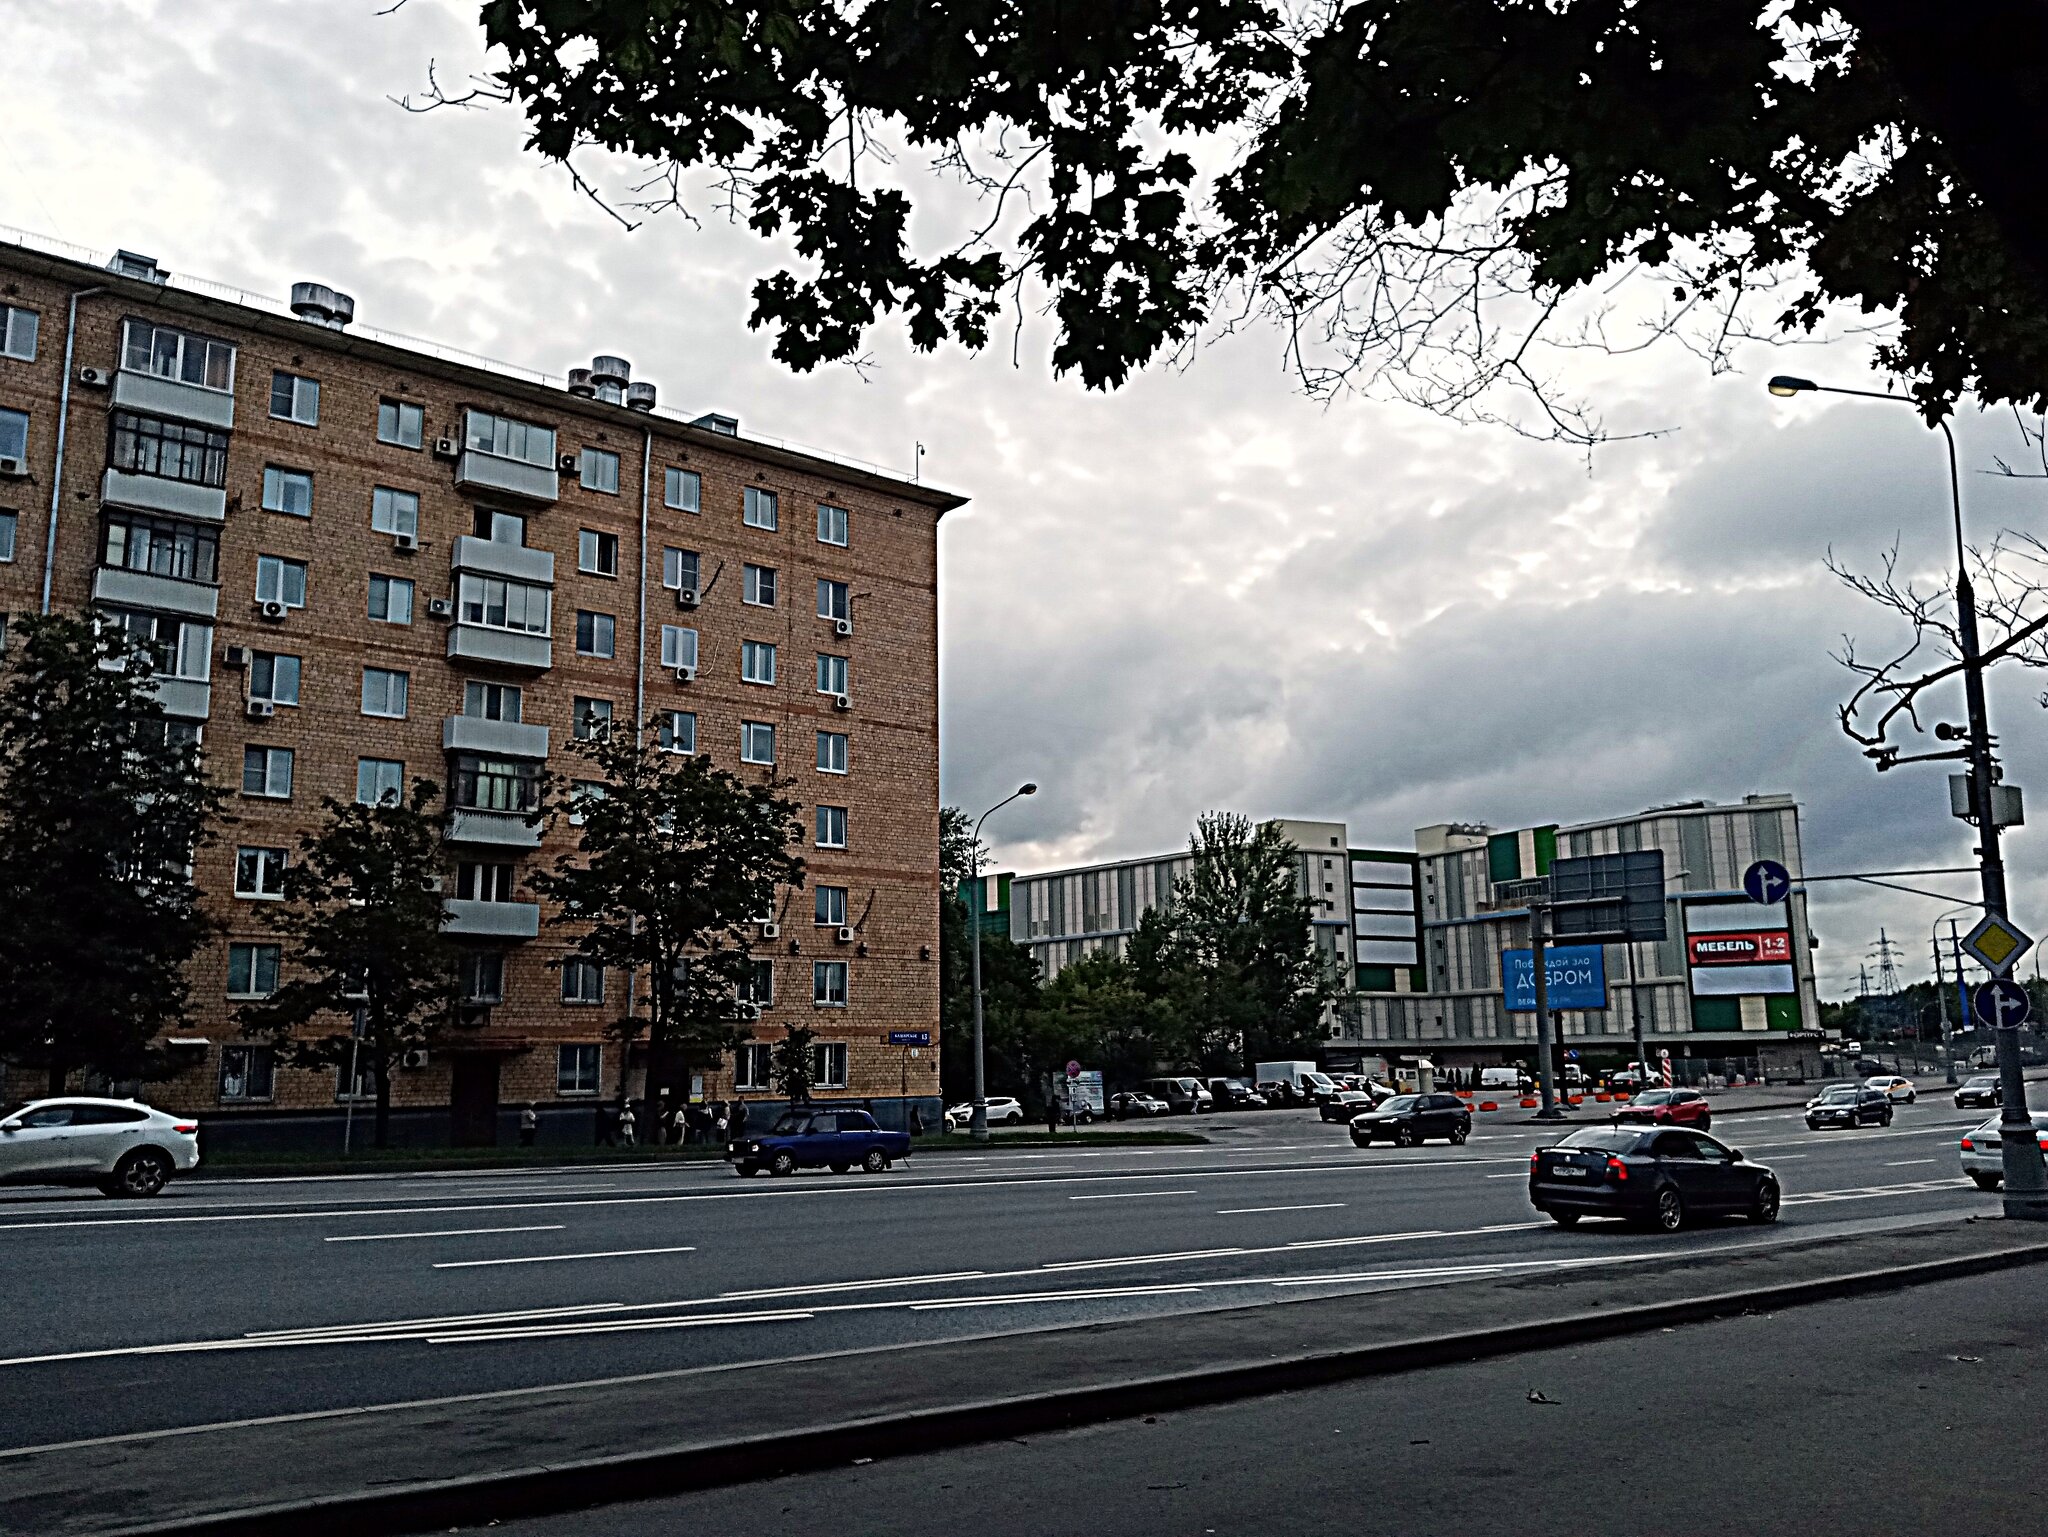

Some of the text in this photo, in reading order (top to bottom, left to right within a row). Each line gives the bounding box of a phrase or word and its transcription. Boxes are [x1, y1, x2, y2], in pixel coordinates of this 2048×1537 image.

[1696, 937, 1785, 952] МЕБЕЛЬ 1-2
[1572, 958, 1590, 967] зло
[1516, 969, 1592, 989] ДОБРОМ
